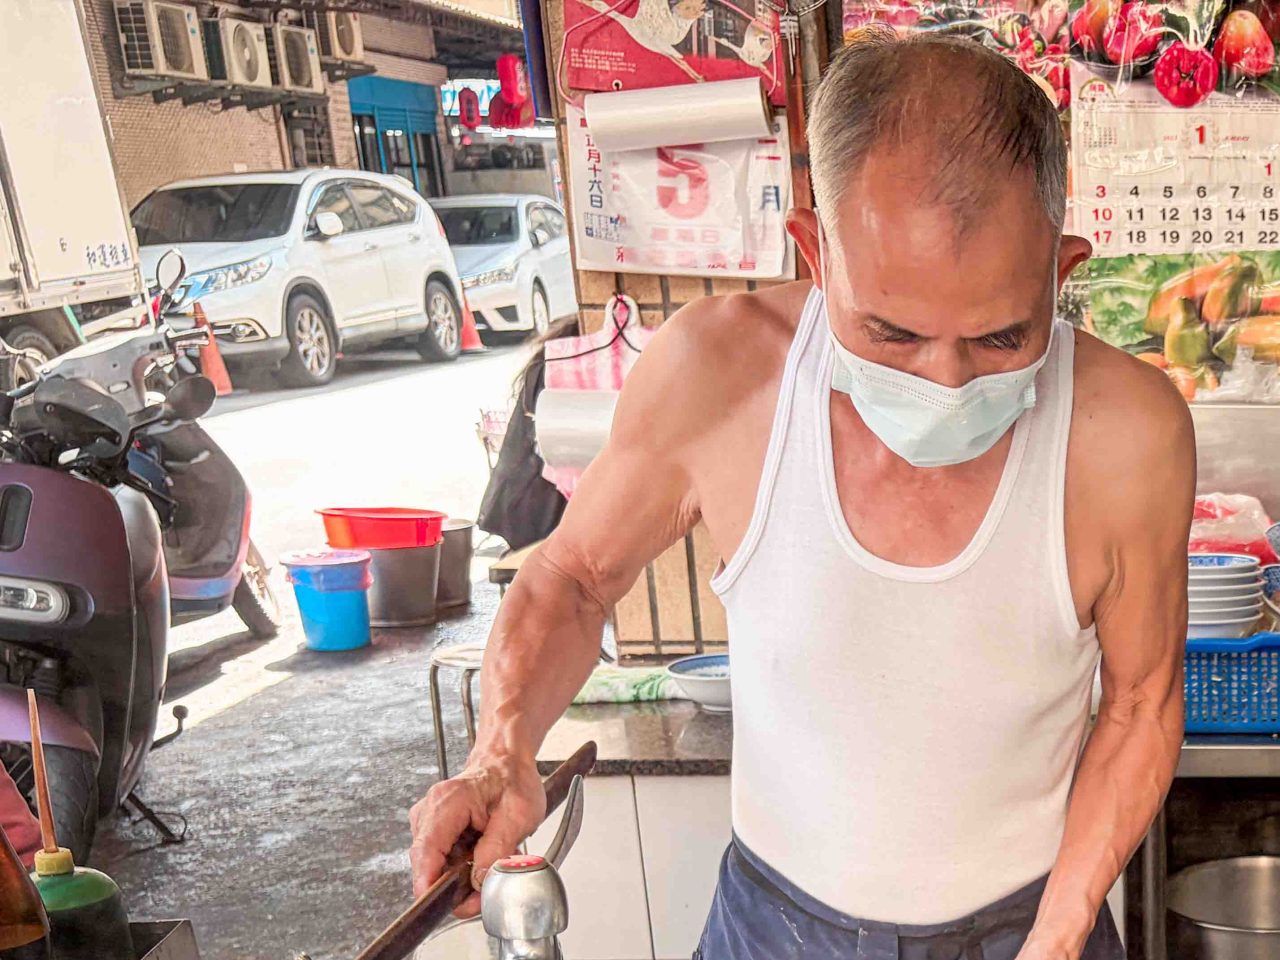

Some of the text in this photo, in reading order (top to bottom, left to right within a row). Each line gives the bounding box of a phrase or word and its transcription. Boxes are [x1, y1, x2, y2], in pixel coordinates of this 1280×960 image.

[1195, 125, 1205, 145] 1
[1265, 163, 1272, 176] 1
[1095, 185, 1106, 198] 3
[1129, 185, 1140, 198] 4
[1163, 186, 1174, 198] 5
[1196, 186, 1207, 198] 6
[1230, 186, 1240, 198] 7
[1262, 186, 1273, 198] 8
[1092, 208, 1113, 221] 10
[1126, 208, 1144, 221] 11
[1159, 208, 1180, 221] 12
[1192, 208, 1212, 221] 13
[1226, 208, 1246, 221] 14
[1259, 208, 1279, 221] 15
[1093, 231, 1112, 244] 17
[1127, 231, 1146, 244] 18
[1160, 231, 1180, 244] 19
[1191, 231, 1213, 244] 20
[1224, 231, 1244, 244] 21
[1258, 231, 1279, 244] 22
